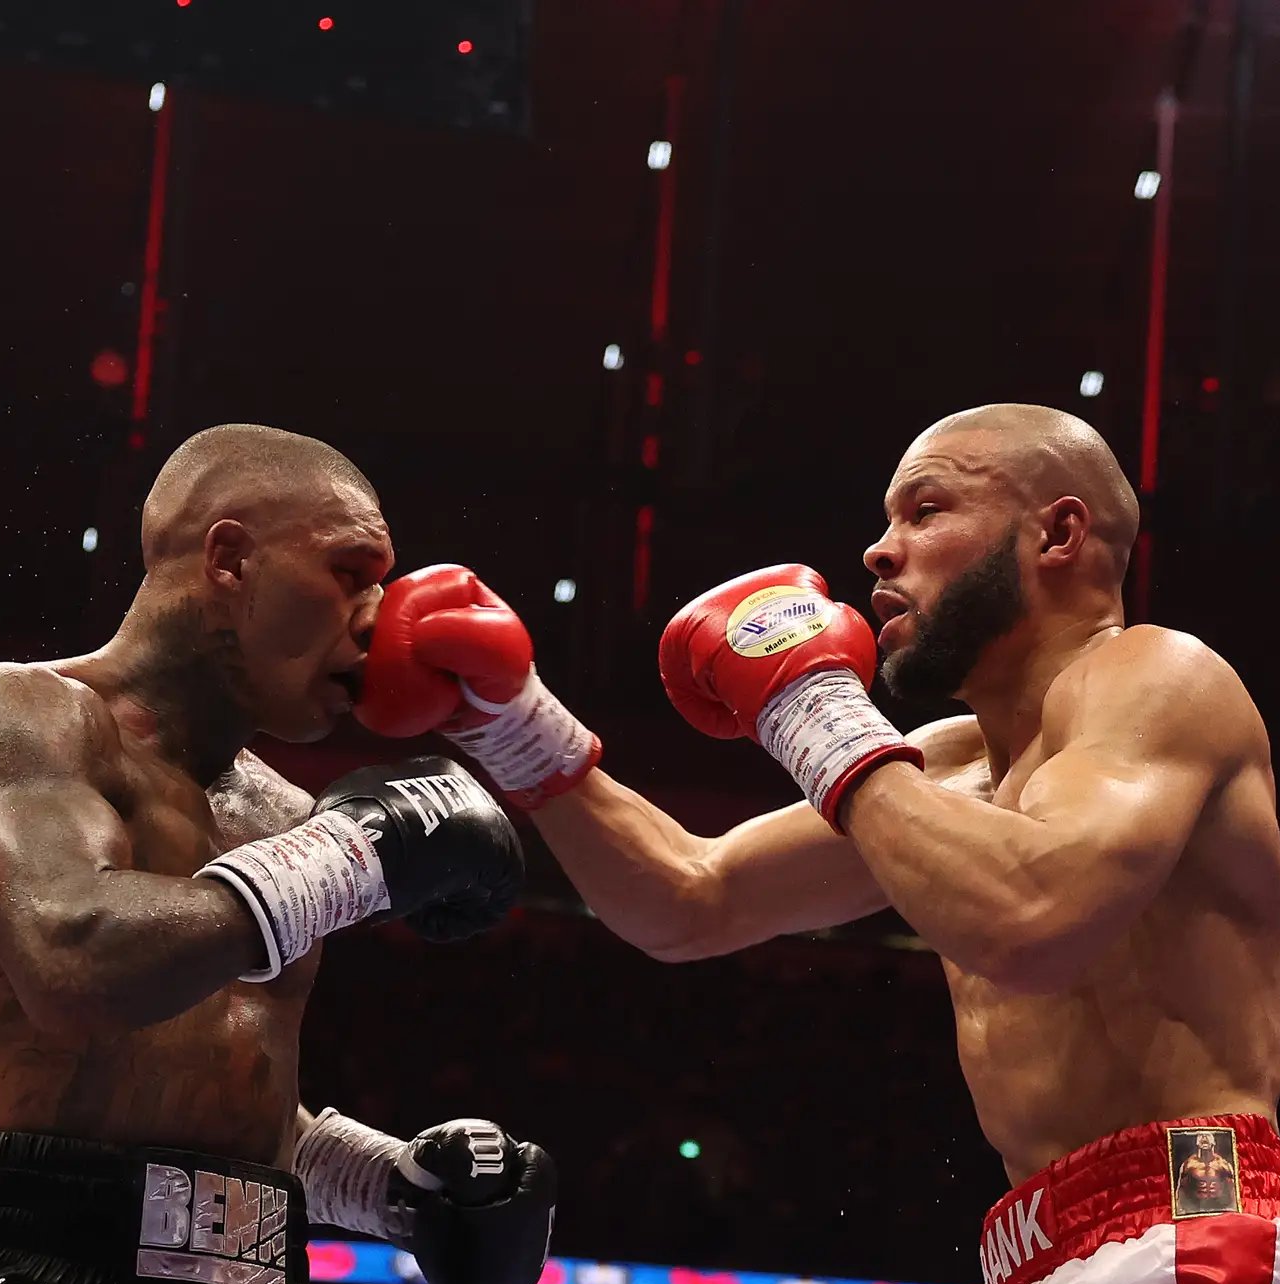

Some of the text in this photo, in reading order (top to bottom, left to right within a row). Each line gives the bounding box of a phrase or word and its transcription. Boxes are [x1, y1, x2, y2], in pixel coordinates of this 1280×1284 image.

[764, 624, 824, 654] Made in PAN
[139, 1163, 288, 1268] BENN
